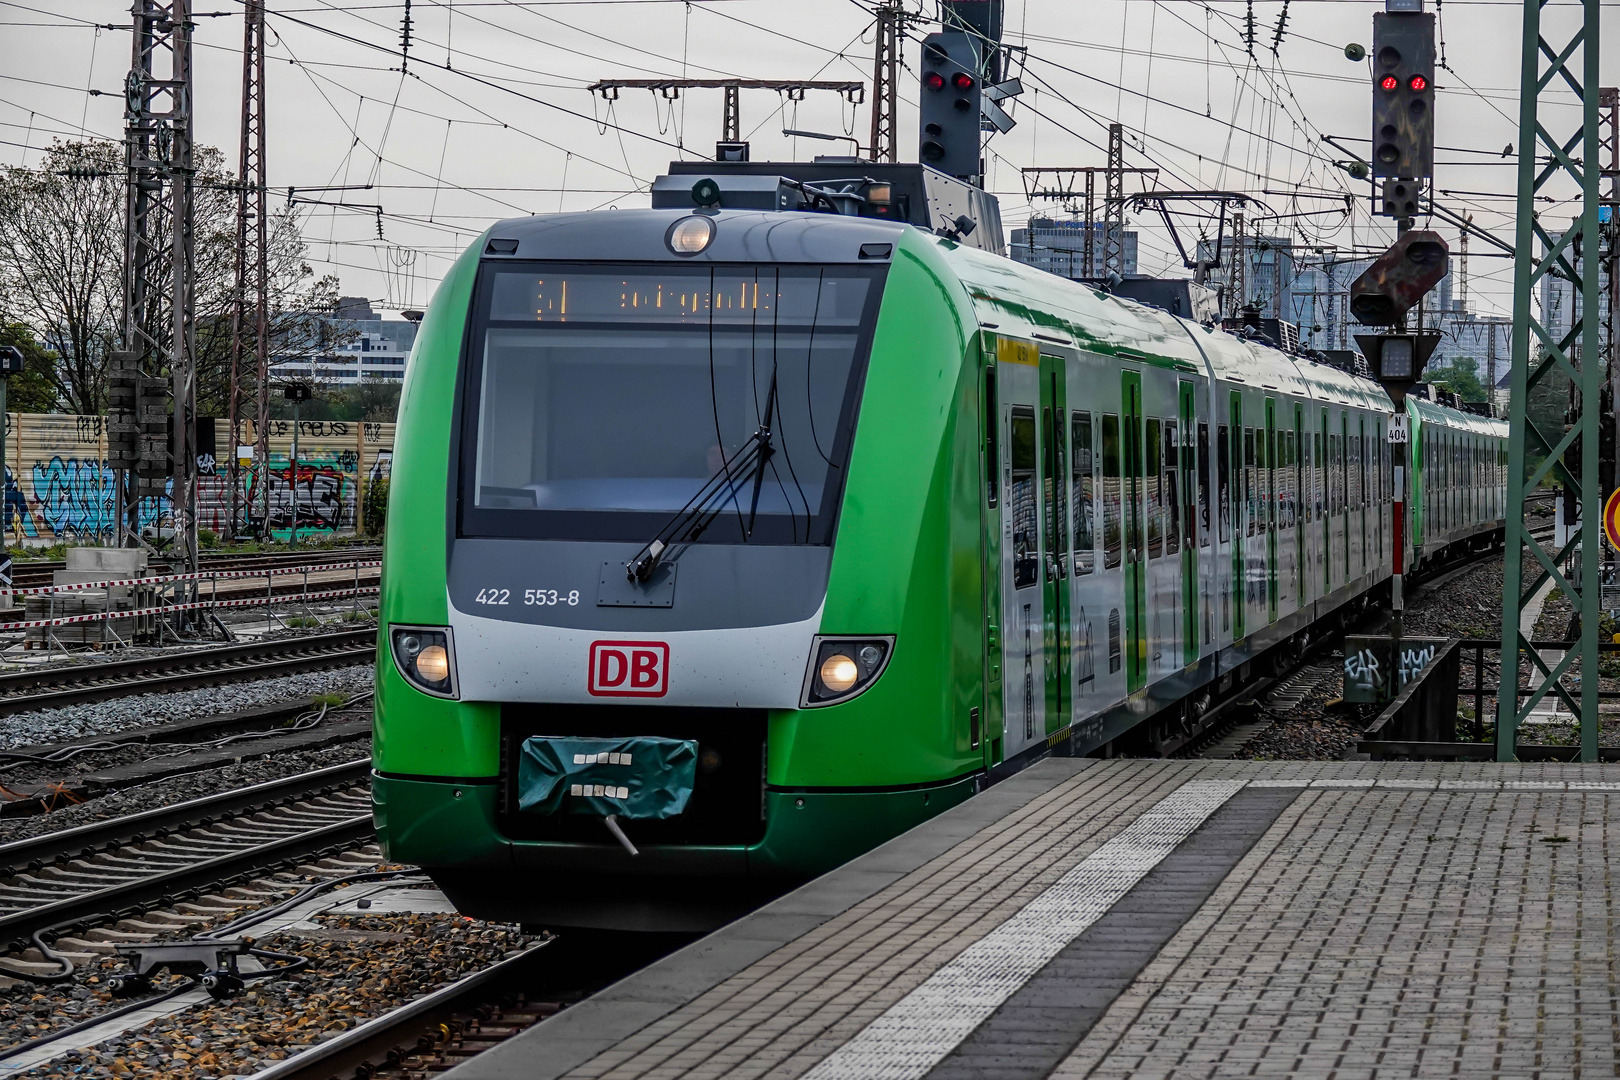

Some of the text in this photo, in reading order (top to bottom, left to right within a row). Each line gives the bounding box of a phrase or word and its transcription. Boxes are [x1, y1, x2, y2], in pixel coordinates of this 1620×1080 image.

[1065, 221, 1104, 229] Postnk
[1395, 417, 1401, 426] N
[1389, 430, 1406, 440] 404
[475, 589, 580, 606] 422 553-8
[599, 650, 659, 688] DB
